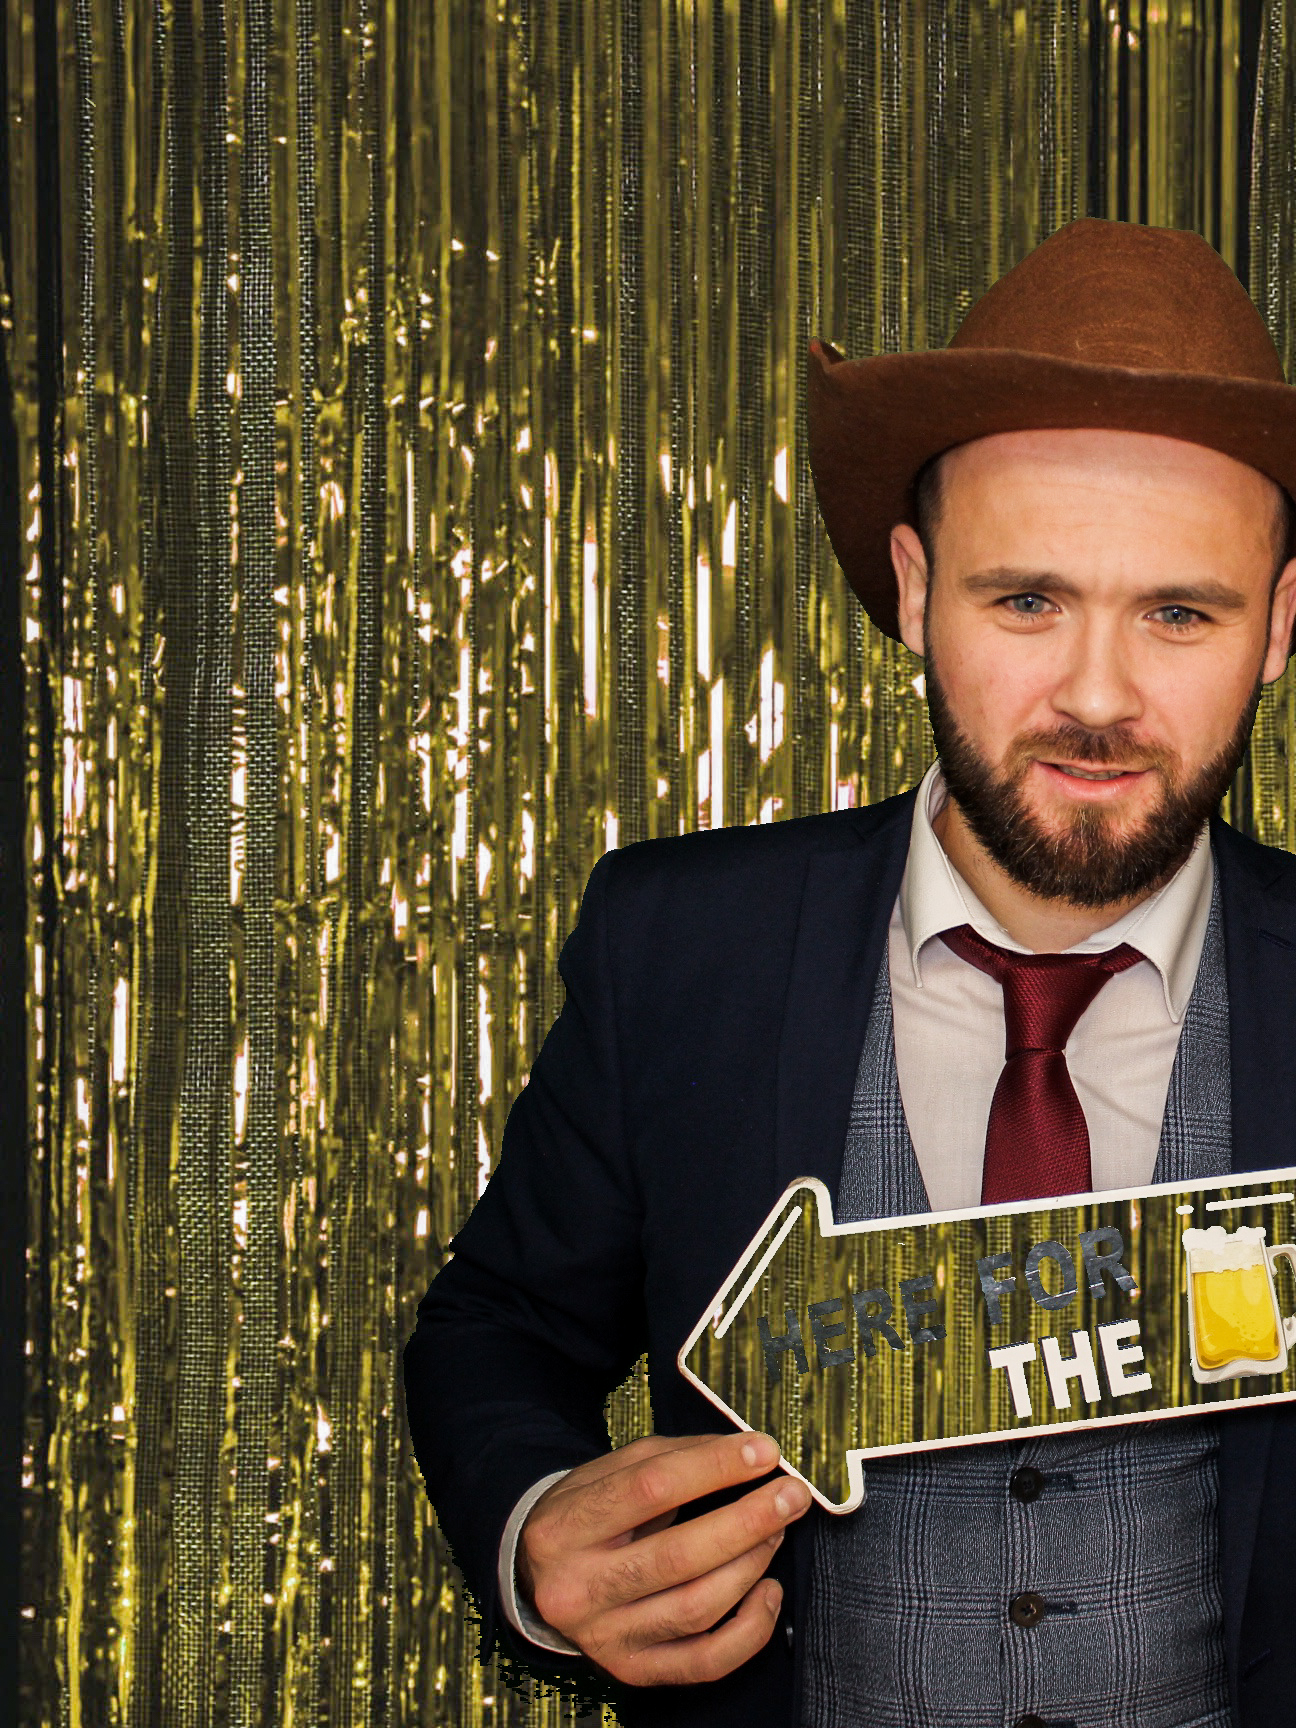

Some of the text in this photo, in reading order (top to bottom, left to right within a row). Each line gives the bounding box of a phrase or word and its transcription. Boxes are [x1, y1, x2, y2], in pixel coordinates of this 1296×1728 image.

[756, 1226, 1138, 1382] HERE FOR
[988, 1319, 1153, 1418] THE
